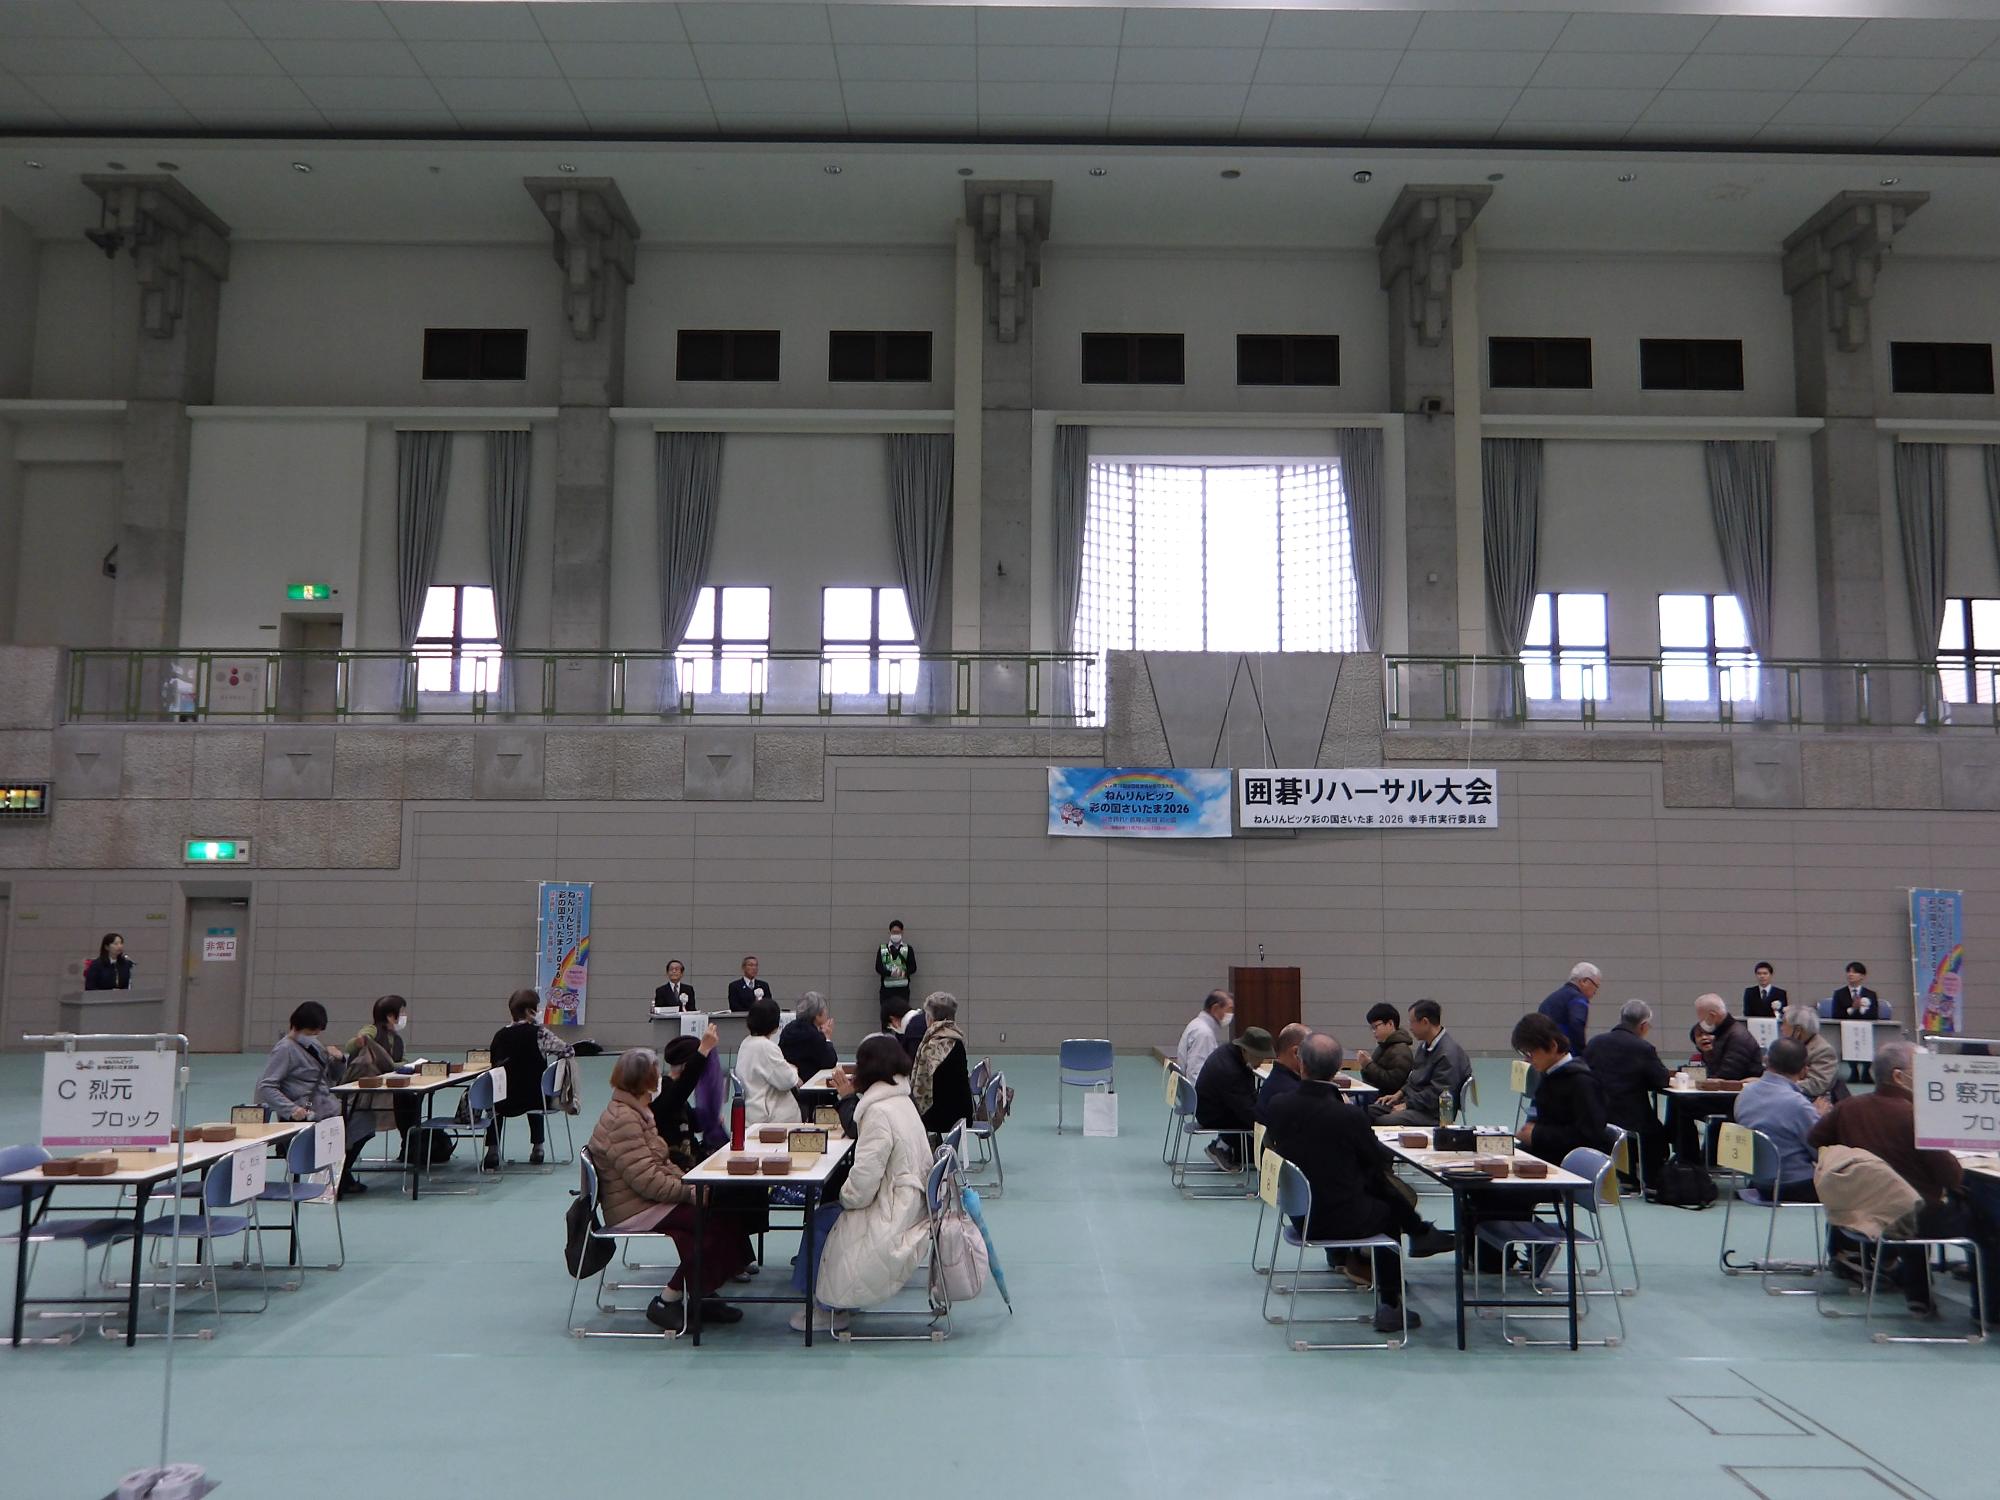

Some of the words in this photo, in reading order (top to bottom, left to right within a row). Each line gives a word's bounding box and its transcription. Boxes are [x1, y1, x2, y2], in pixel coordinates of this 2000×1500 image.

[1104, 790, 1175, 801] ねんりんピック
[1245, 777, 1493, 806] 囲碁リハーサル大会
[1089, 802, 1190, 814] 彩の国さいたま2026
[1253, 814, 1375, 824] ねんりんピック彩の国さいたま
[1379, 814, 1404, 824] 2026
[1408, 814, 1487, 824] 幸手市実行委員会
[566, 891, 576, 945] ねんりんピック
[206, 941, 234, 951] 非常口
[58, 1079, 77, 1100] C
[88, 1078, 133, 1100] 烈元
[1928, 1081, 1945, 1102] B
[1955, 1082, 2000, 1104] 察元
[91, 1110, 160, 1128] ブロック
[1962, 1114, 2000, 1131] ブロ
[327, 1142, 333, 1153] 7
[1731, 1147, 1738, 1159] 3
[246, 1174, 252, 1186] 8
